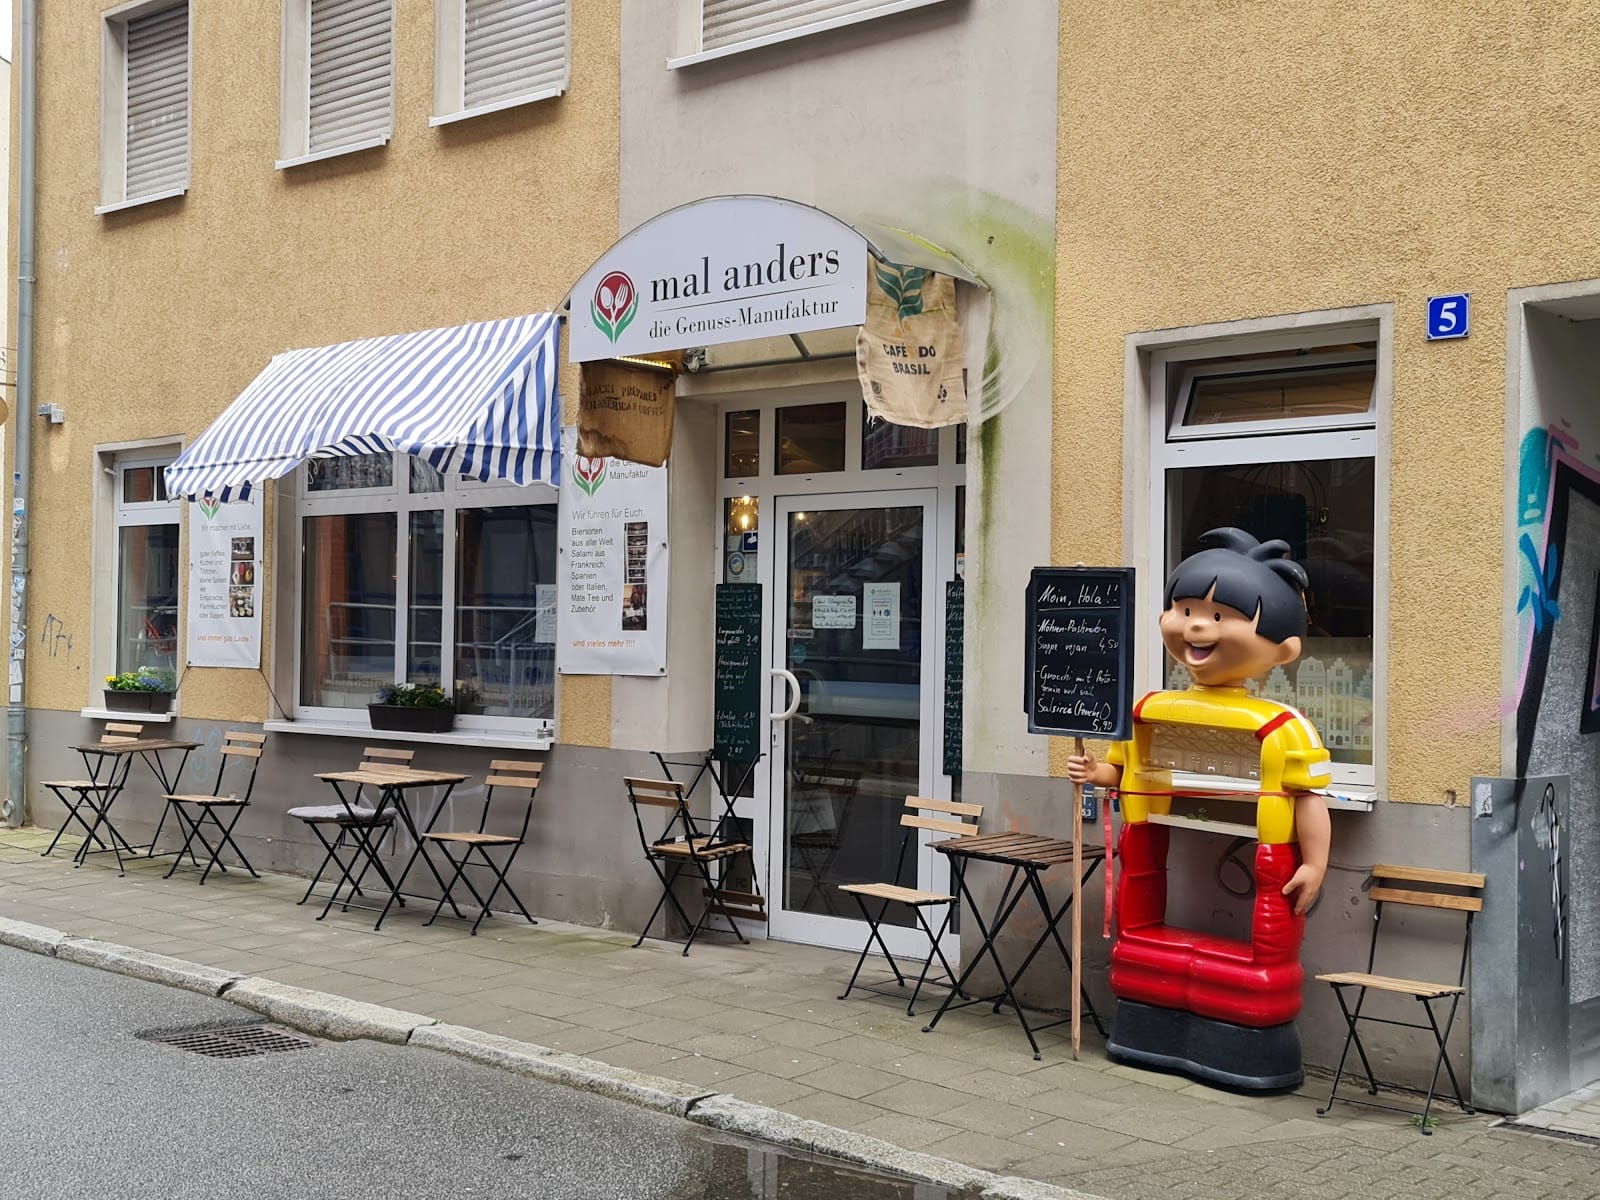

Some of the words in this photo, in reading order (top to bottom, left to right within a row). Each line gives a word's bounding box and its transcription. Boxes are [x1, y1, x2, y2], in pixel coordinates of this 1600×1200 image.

[650, 256, 711, 302] mal
[723, 243, 840, 291] anders
[649, 320, 671, 339] die
[676, 299, 839, 335] Genuss-Manufaktur
[1438, 301, 1457, 333] 5
[883, 342, 908, 358] CAFÉ
[919, 346, 936, 358] DO
[893, 362, 931, 375] BRASIL
[610, 470, 649, 481] Manufaktur
[571, 511, 586, 520] Wir
[612, 509, 622, 518] für
[571, 528, 602, 536] Biersorten
[571, 550, 593, 558] Salami
[571, 572, 597, 580] Spanien
[571, 583, 585, 591] oder
[571, 594, 586, 602] Mate
[588, 594, 599, 602] Tee
[602, 594, 614, 602] und
[1037, 584, 1072, 607] Moin,
[571, 605, 597, 613] Zubehör
[573, 639, 586, 647] und
[587, 639, 606, 647] vieles
[608, 639, 624, 648] mehr
[1092, 719, 1113, 732] 5,90
